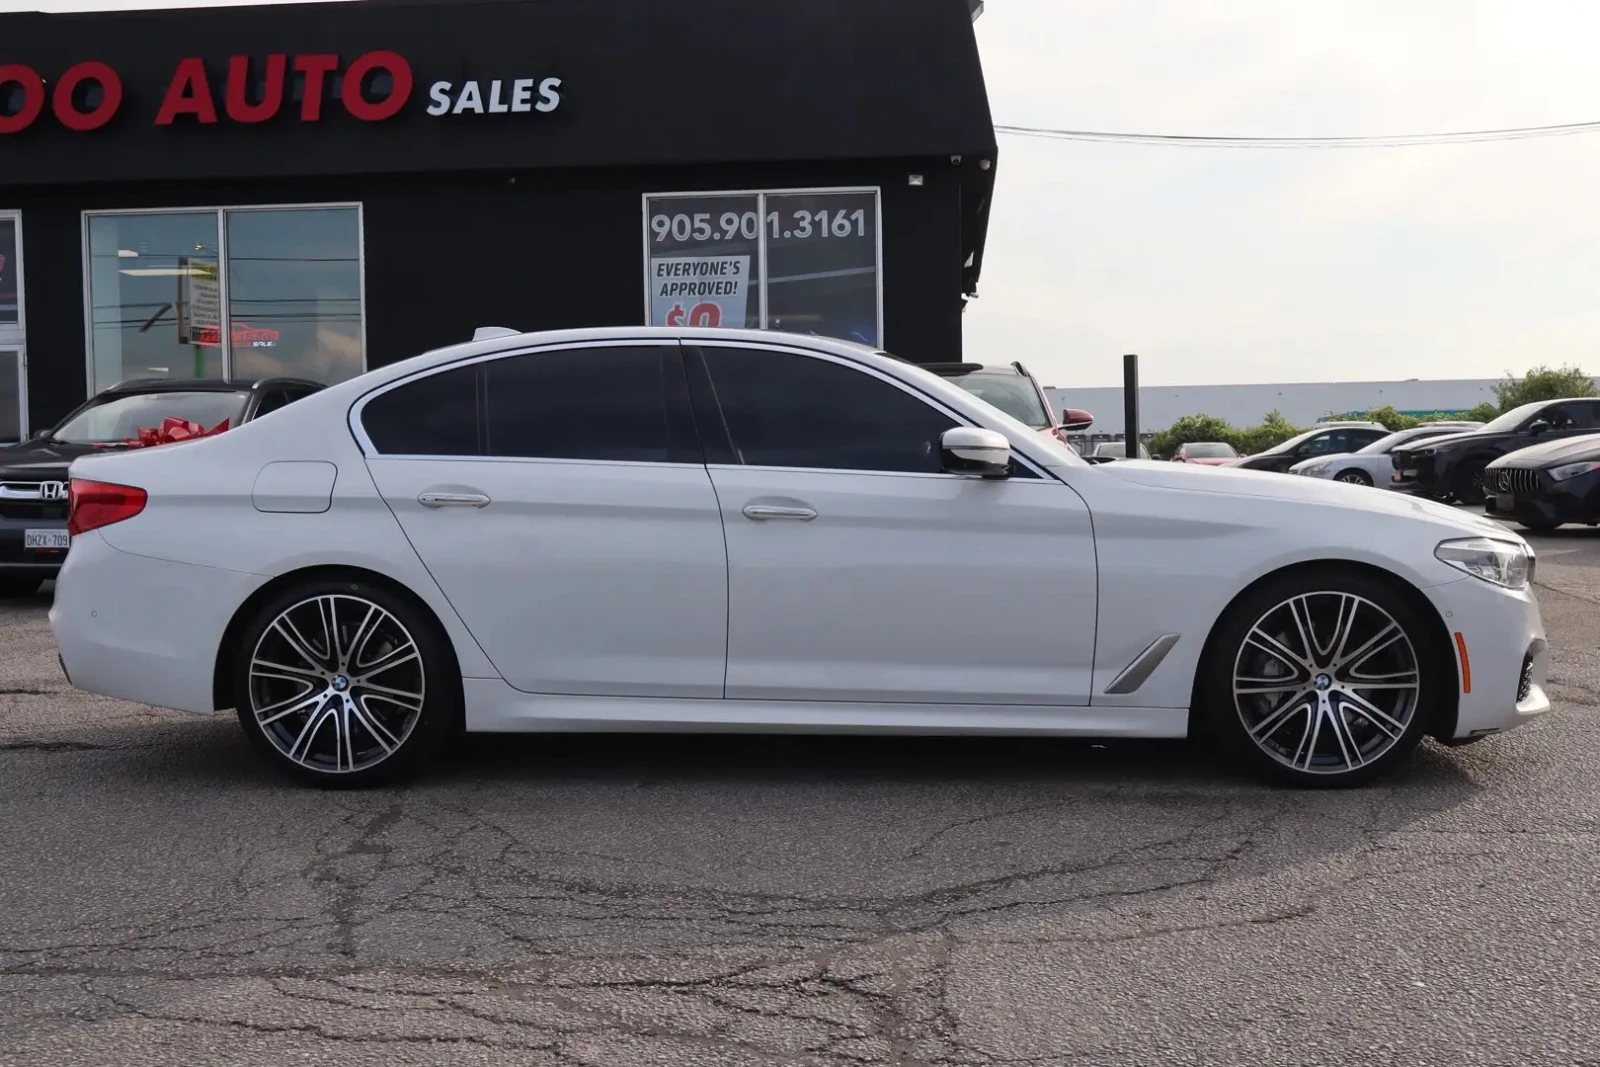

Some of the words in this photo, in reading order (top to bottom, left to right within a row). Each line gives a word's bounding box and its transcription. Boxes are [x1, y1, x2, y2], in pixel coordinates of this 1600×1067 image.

[154, 49, 413, 126] AUTO
[426, 76, 563, 116] SALES
[650, 208, 866, 242] 905.901.3161
[656, 260, 741, 277] EVERYONE'S
[659, 281, 738, 297] APPROVED!
